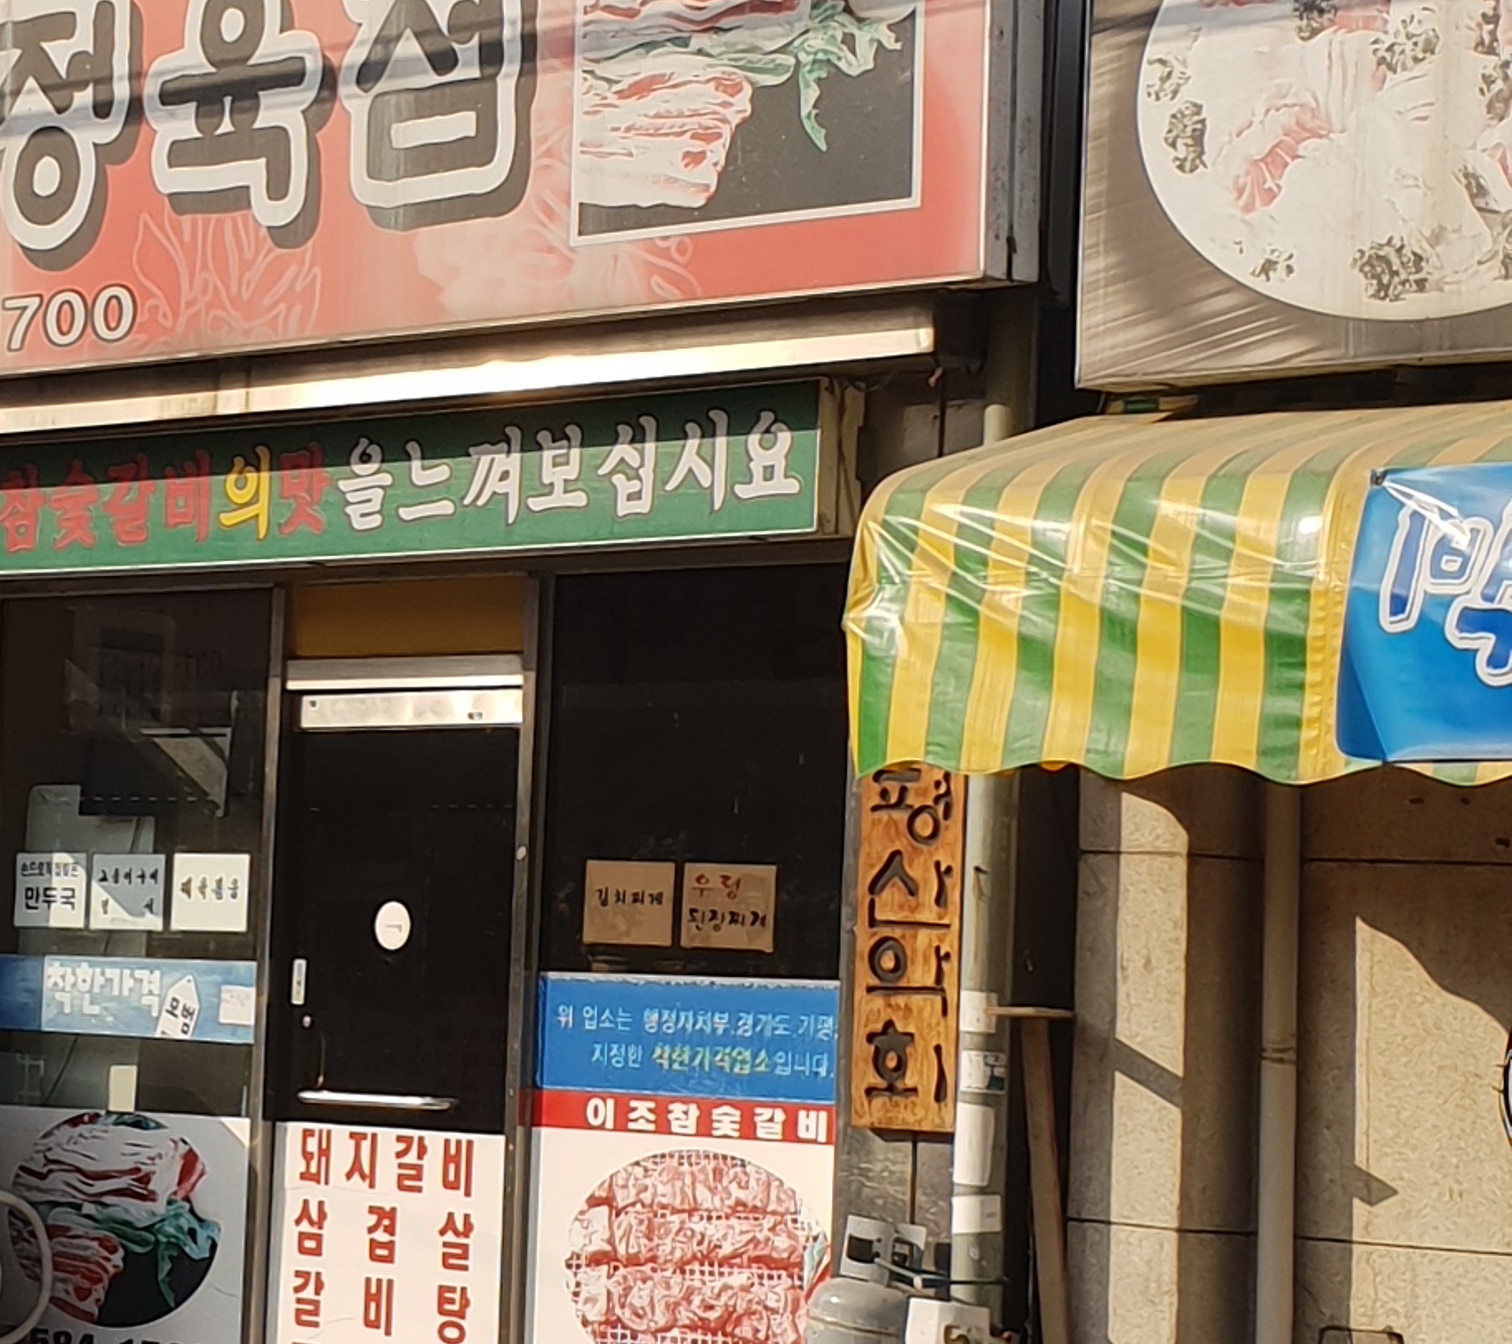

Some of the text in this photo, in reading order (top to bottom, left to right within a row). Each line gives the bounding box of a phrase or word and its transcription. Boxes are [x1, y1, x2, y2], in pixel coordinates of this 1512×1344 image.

[24, 886, 76, 911] 만두국
[46, 961, 161, 1018] 착한가격
[585, 1097, 828, 1145] 이조참숯갈비
[298, 1127, 474, 1198] 돼지갈비
[294, 1198, 474, 1273] 삼겹살
